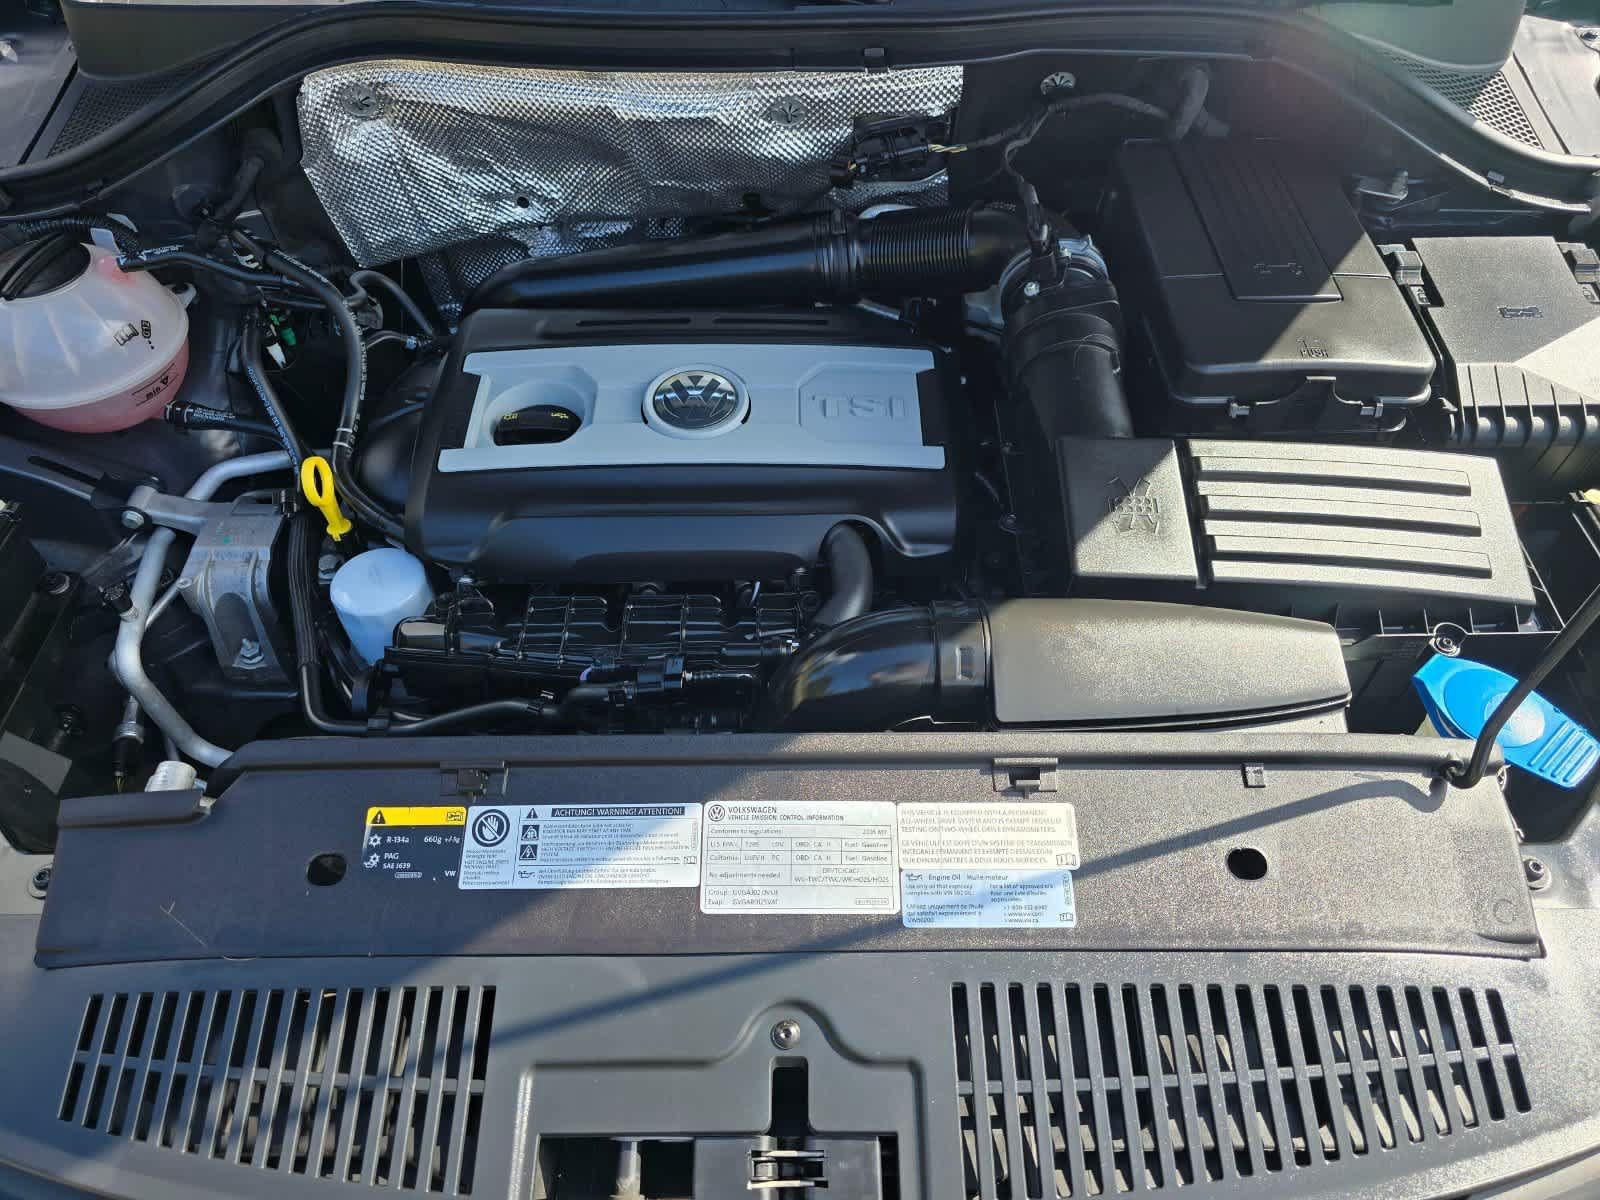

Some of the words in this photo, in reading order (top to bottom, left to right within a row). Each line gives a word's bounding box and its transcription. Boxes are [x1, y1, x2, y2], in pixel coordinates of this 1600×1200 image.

[812, 394, 905, 418] TSI
[554, 808, 595, 817] ACHTUNG!
[597, 808, 637, 816] WARNING!
[638, 807, 683, 816] ATTENTION!
